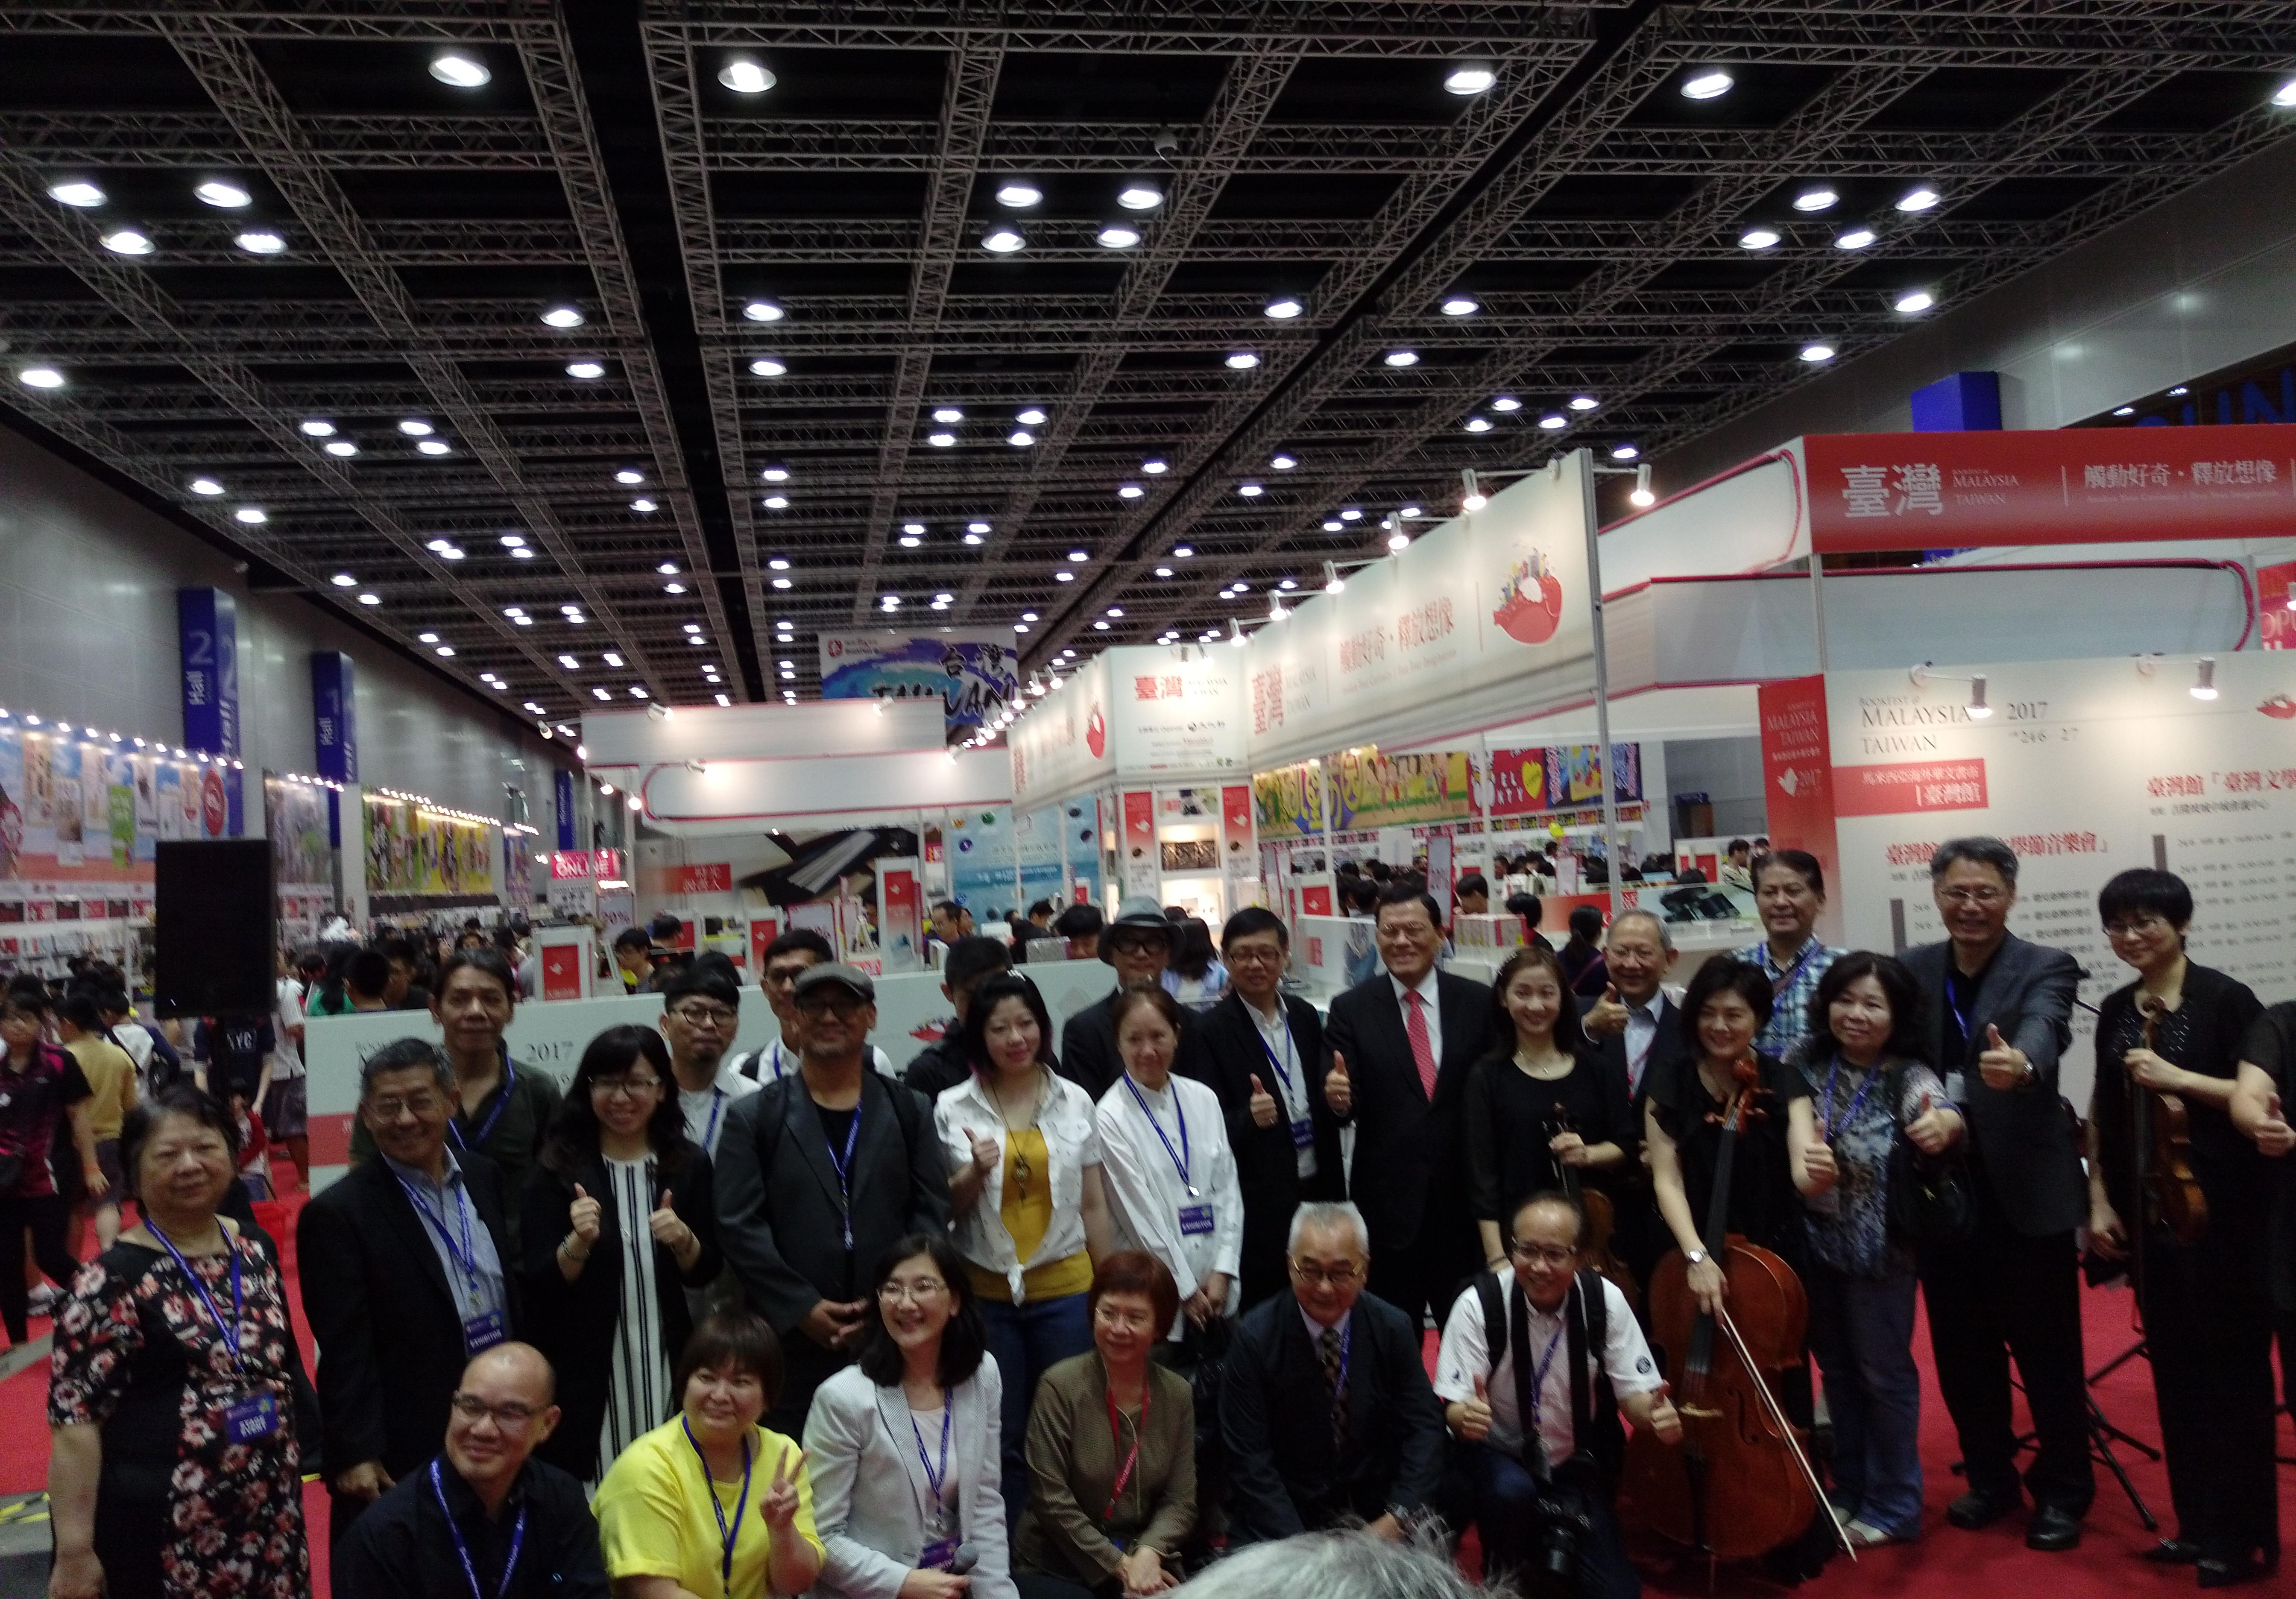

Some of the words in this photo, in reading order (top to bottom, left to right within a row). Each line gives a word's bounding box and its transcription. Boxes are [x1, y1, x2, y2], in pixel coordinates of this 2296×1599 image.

[1840, 463, 1944, 518] 臺灣
[1861, 705, 1973, 728] MALAYSIA
[2006, 701, 2048, 720] 2017
[1860, 733, 1937, 754] TAIWAN
[525, 1041, 574, 1063] 2017
